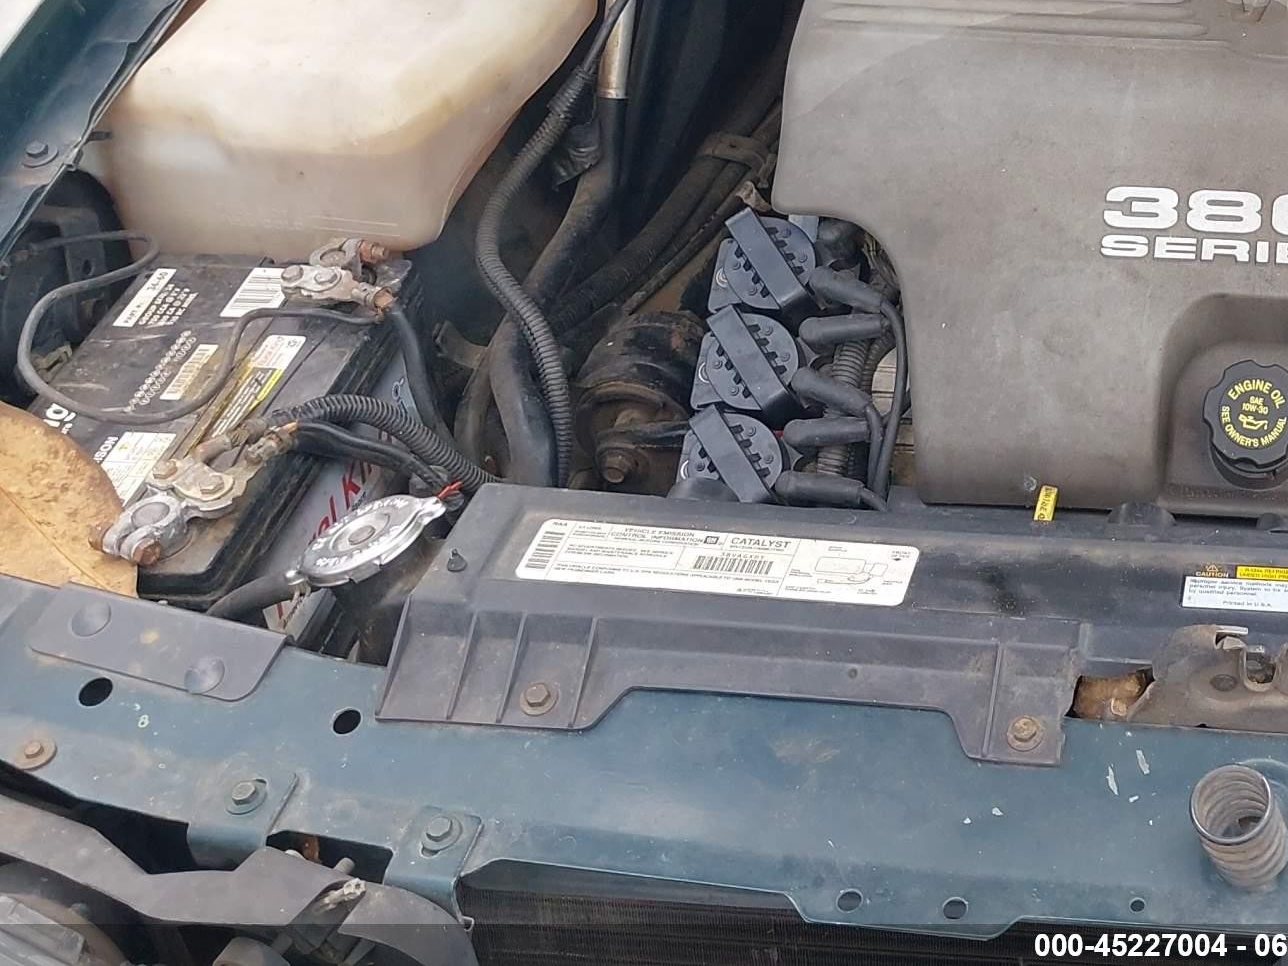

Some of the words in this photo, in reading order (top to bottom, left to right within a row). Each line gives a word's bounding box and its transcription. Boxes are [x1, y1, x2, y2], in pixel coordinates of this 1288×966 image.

[1227, 379, 1273, 401] ENGINE
[1270, 389, 1286, 409] OIL
[1249, 396, 1264, 405] SAE
[1221, 405, 1231, 424] SEE
[1242, 402, 1269, 415] 10W-30
[1225, 424, 1260, 447] OWNER'S
[1261, 416, 1287, 446] MANUAL
[731, 537, 792, 548] CATALYST
